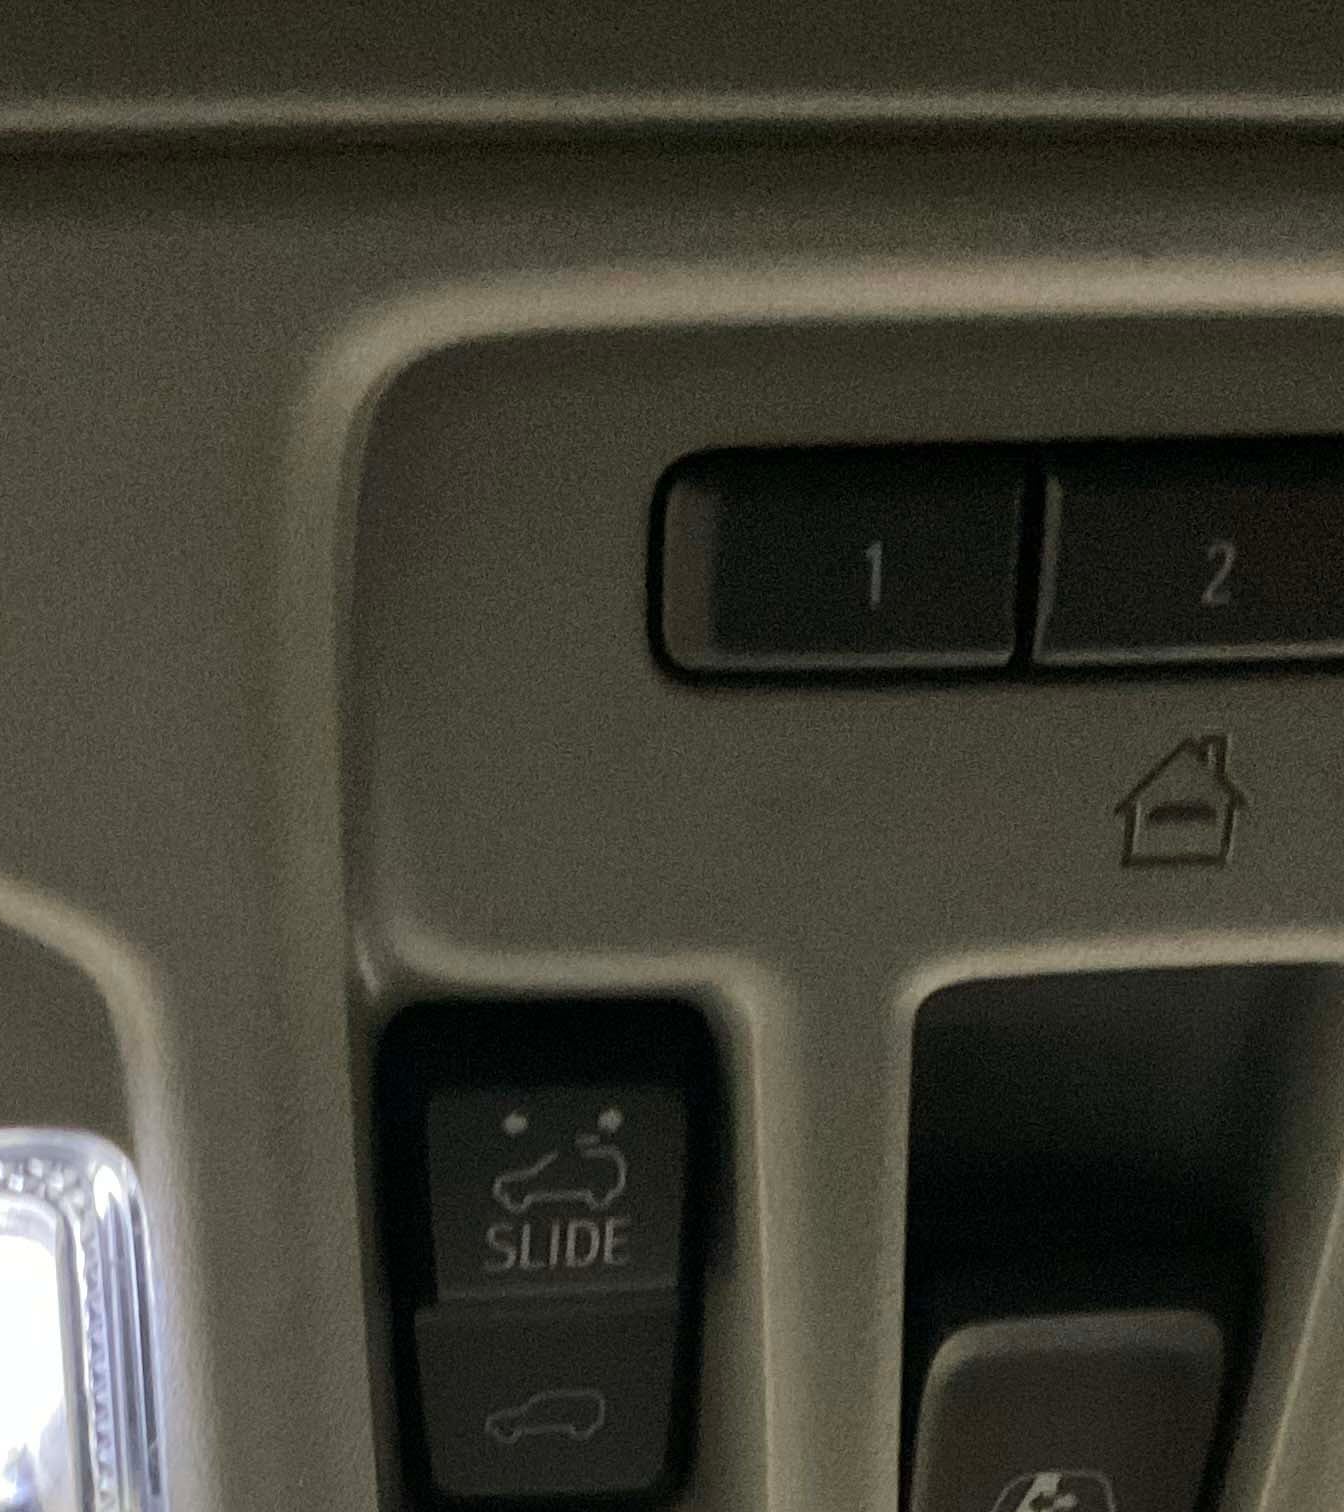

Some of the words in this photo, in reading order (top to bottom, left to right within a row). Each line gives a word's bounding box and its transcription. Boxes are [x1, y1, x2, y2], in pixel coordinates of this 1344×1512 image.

[864, 540, 885, 608] 1
[1200, 540, 1238, 604] 2
[484, 1216, 632, 1273] SLIDE
